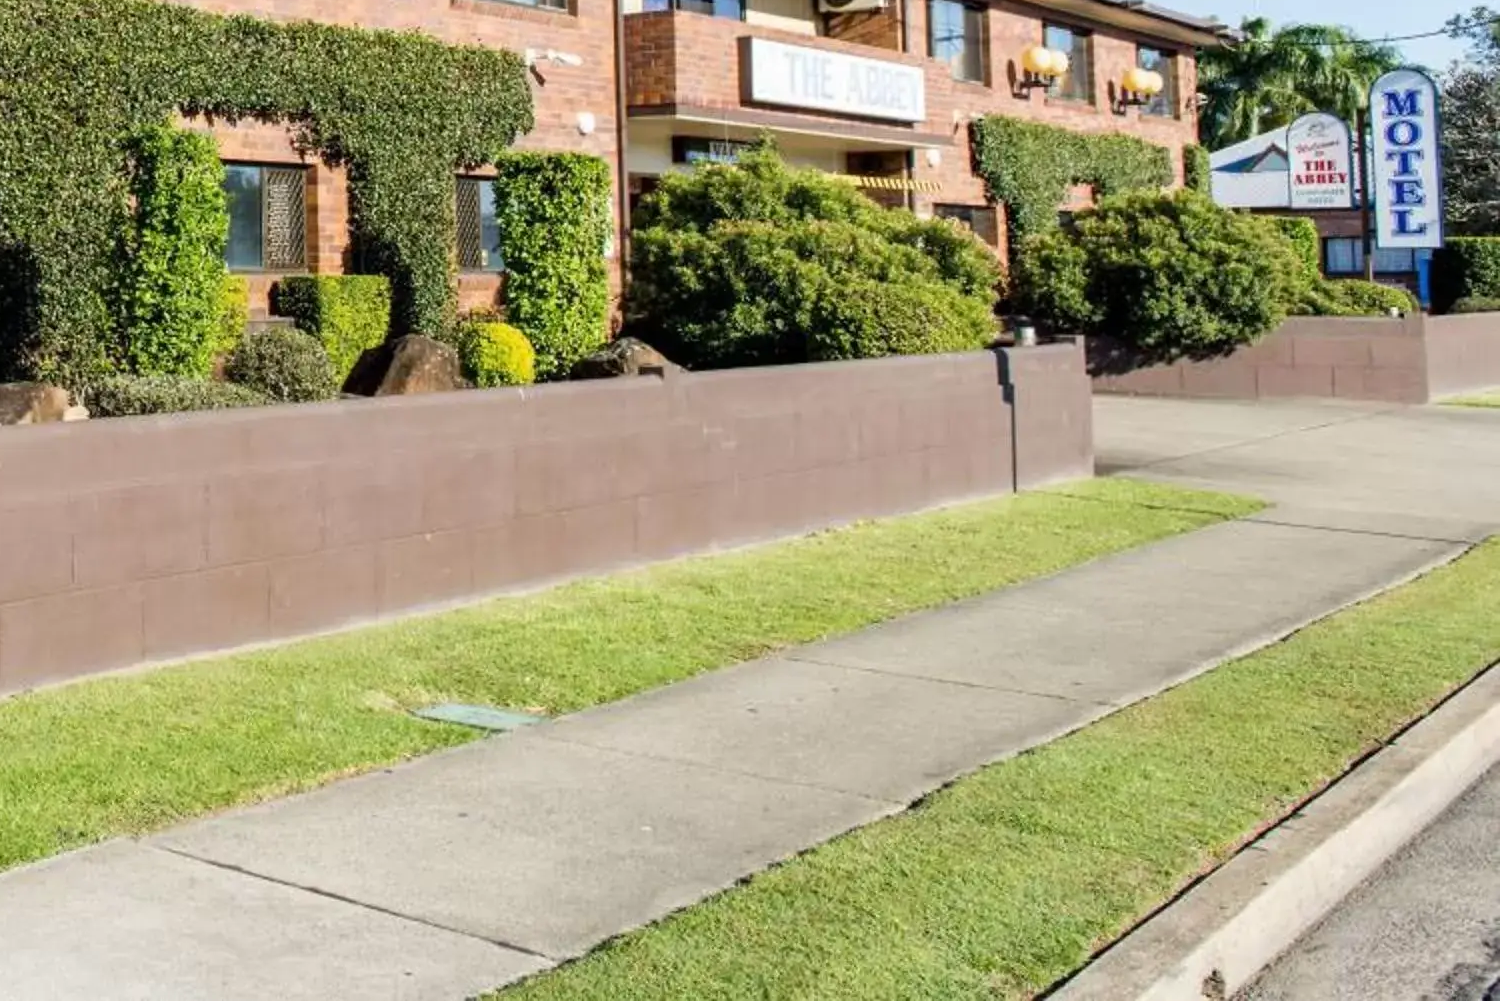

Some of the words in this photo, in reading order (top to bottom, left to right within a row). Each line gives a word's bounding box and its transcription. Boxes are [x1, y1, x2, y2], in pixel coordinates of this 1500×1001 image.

[784, 51, 835, 101] THE
[1303, 160, 1337, 171] THE
[1381, 88, 1427, 237] MOTEL
[1294, 172, 1347, 185] ABBEY
